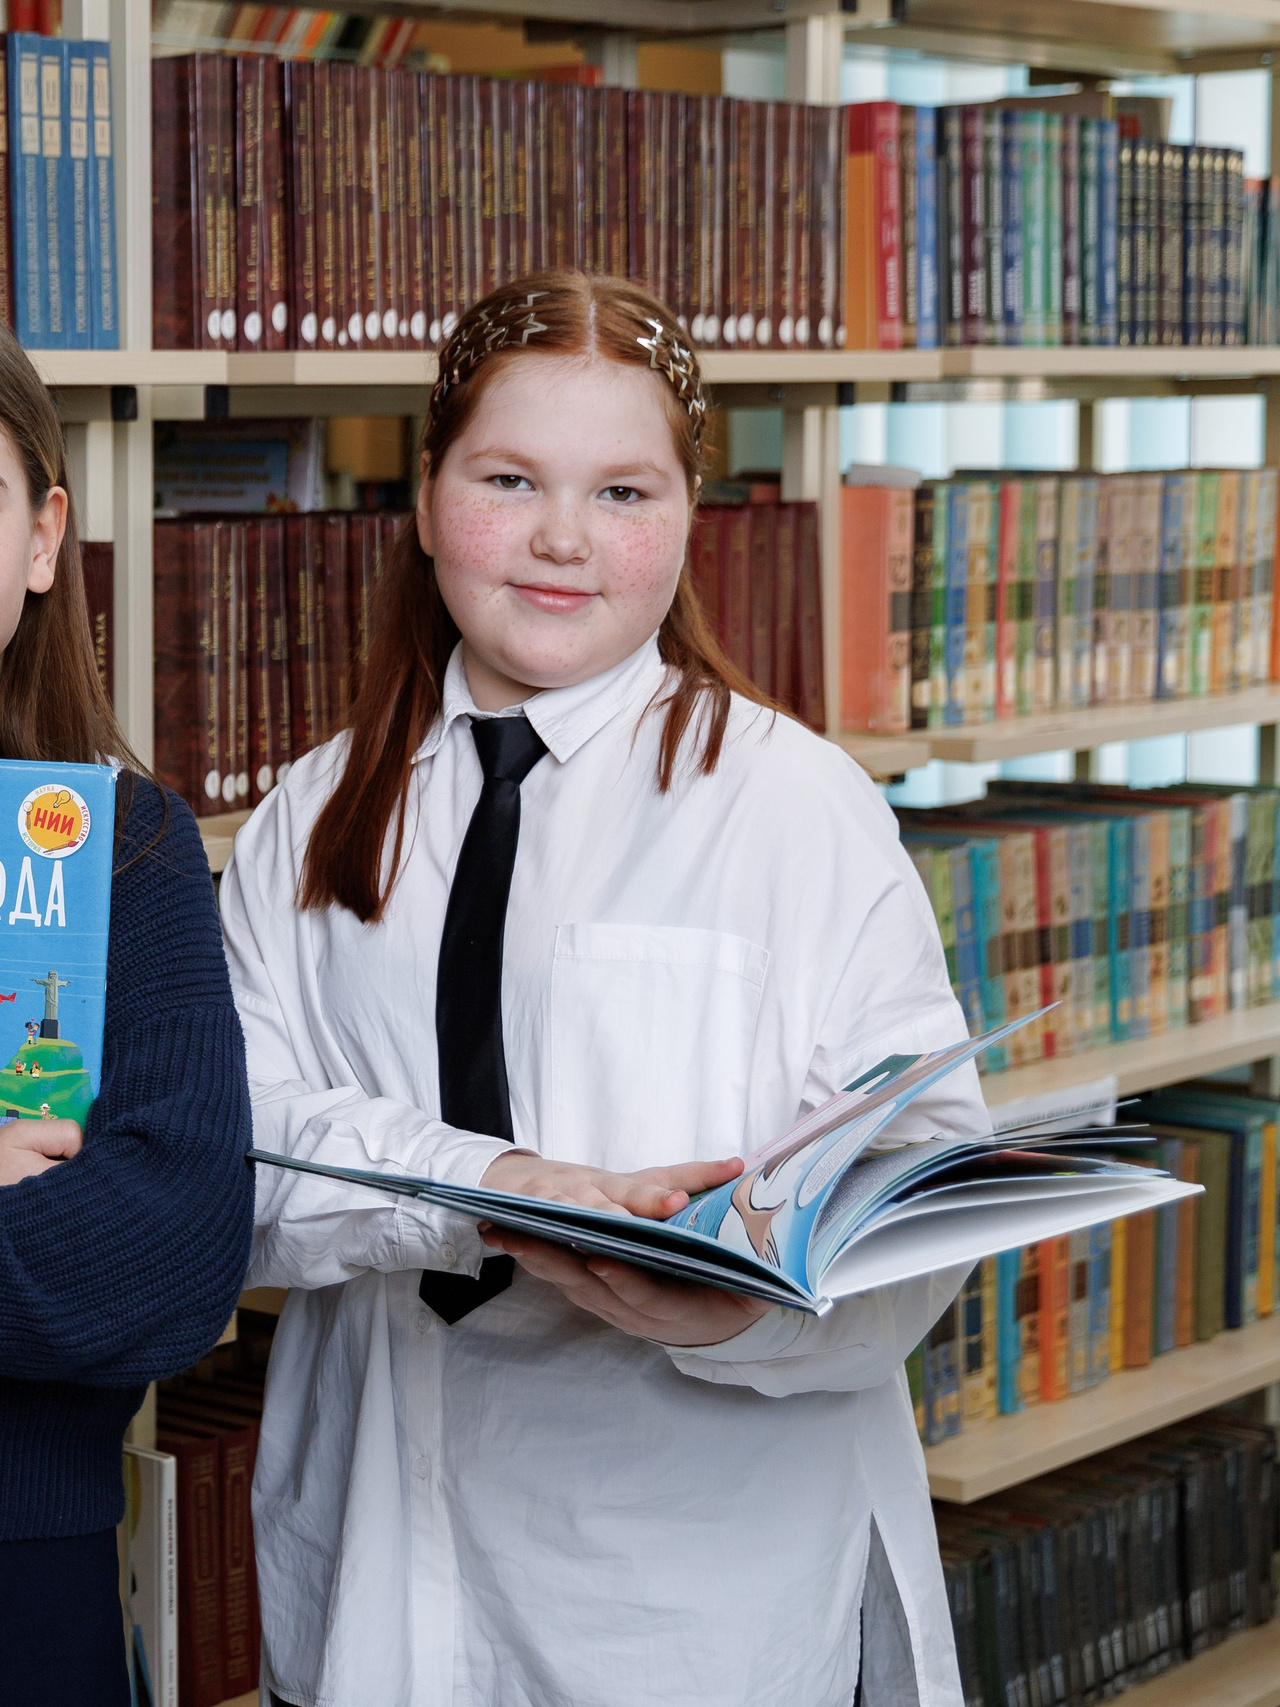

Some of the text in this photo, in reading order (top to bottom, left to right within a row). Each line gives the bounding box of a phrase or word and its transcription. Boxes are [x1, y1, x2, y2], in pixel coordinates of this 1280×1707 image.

[34, 785, 55, 797] НАУКА
[33, 807, 75, 836] НИИ
[78, 805, 90, 842] ИСКУССТВО
[21, 832, 42, 853] ИСТОРИЯ
